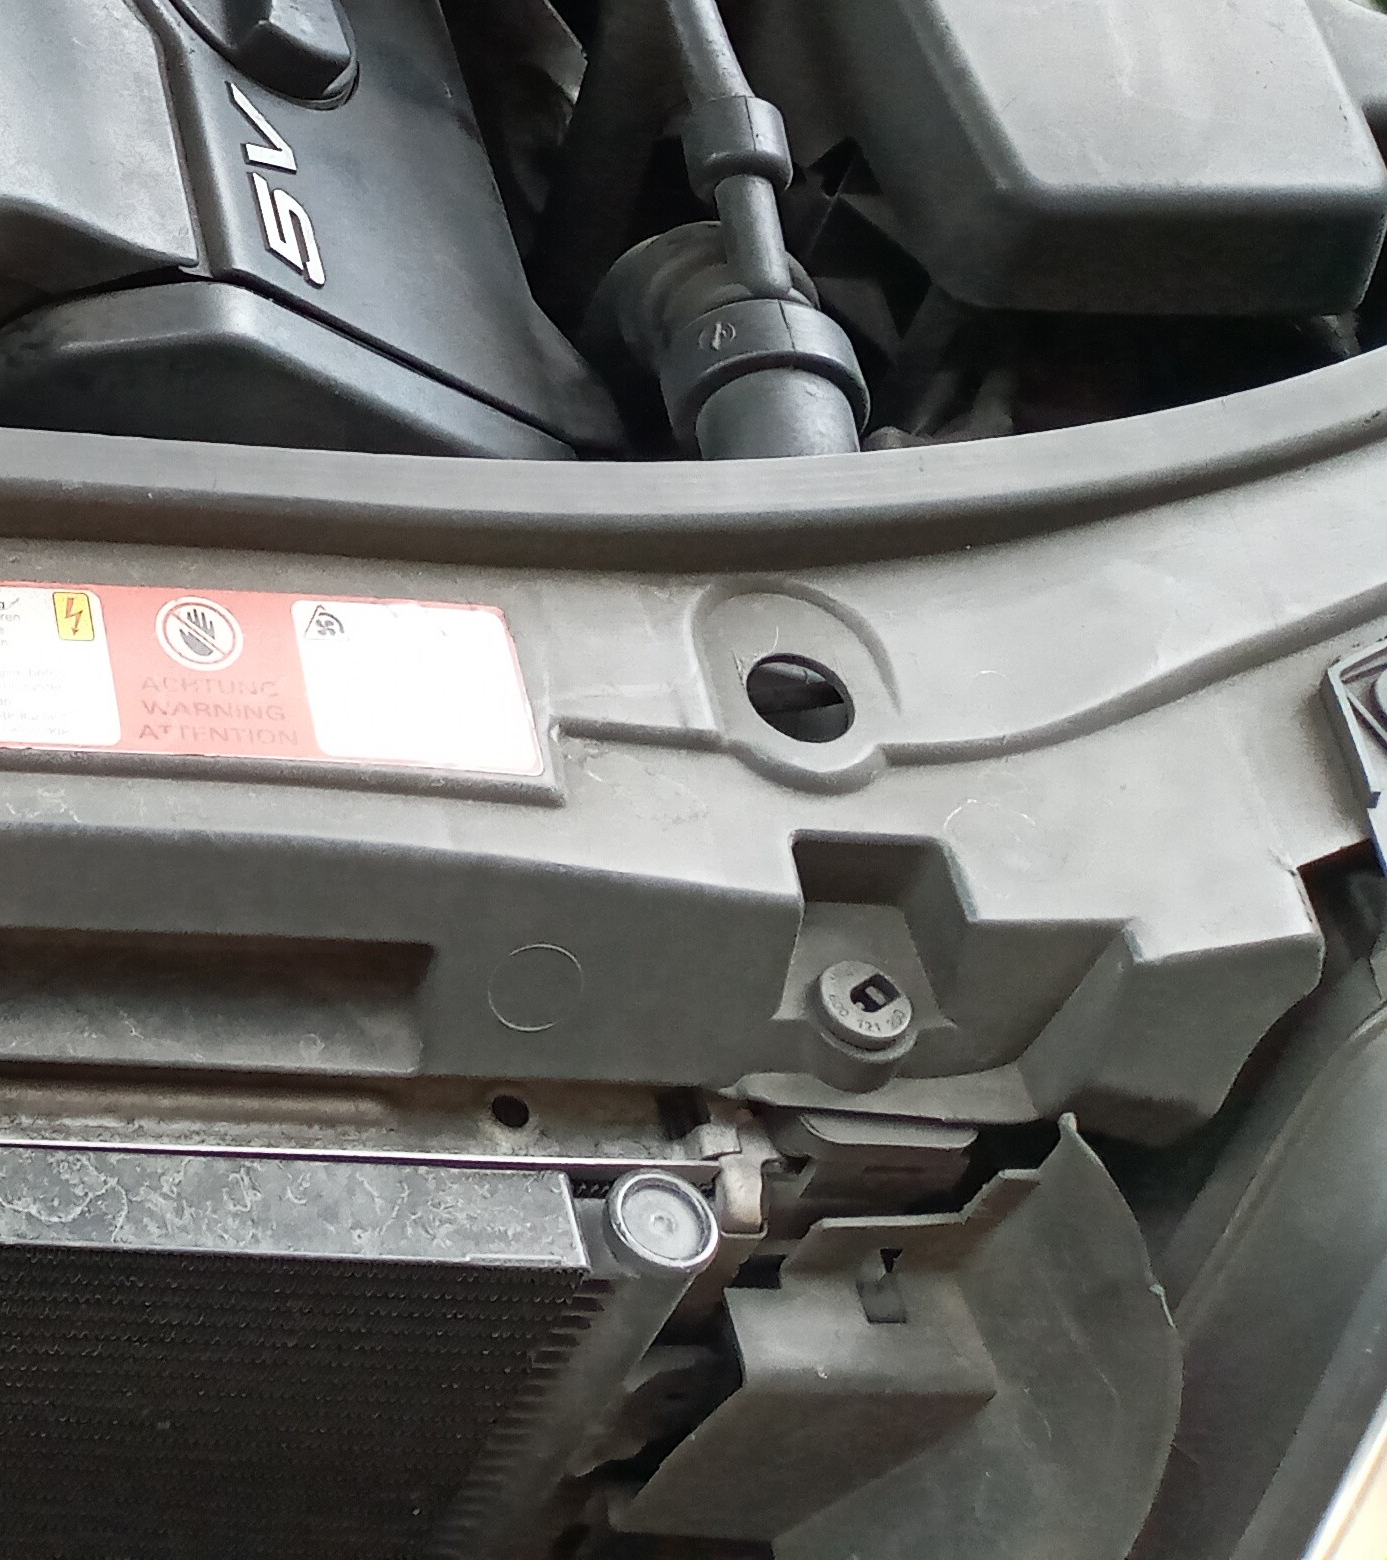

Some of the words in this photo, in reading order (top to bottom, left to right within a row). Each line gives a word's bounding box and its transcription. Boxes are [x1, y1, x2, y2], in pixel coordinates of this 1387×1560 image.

[225, 81, 327, 288] 5V
[141, 676, 280, 697] ACHTUNG
[140, 699, 287, 721] WARNING
[138, 724, 299, 746] ATTENTION
